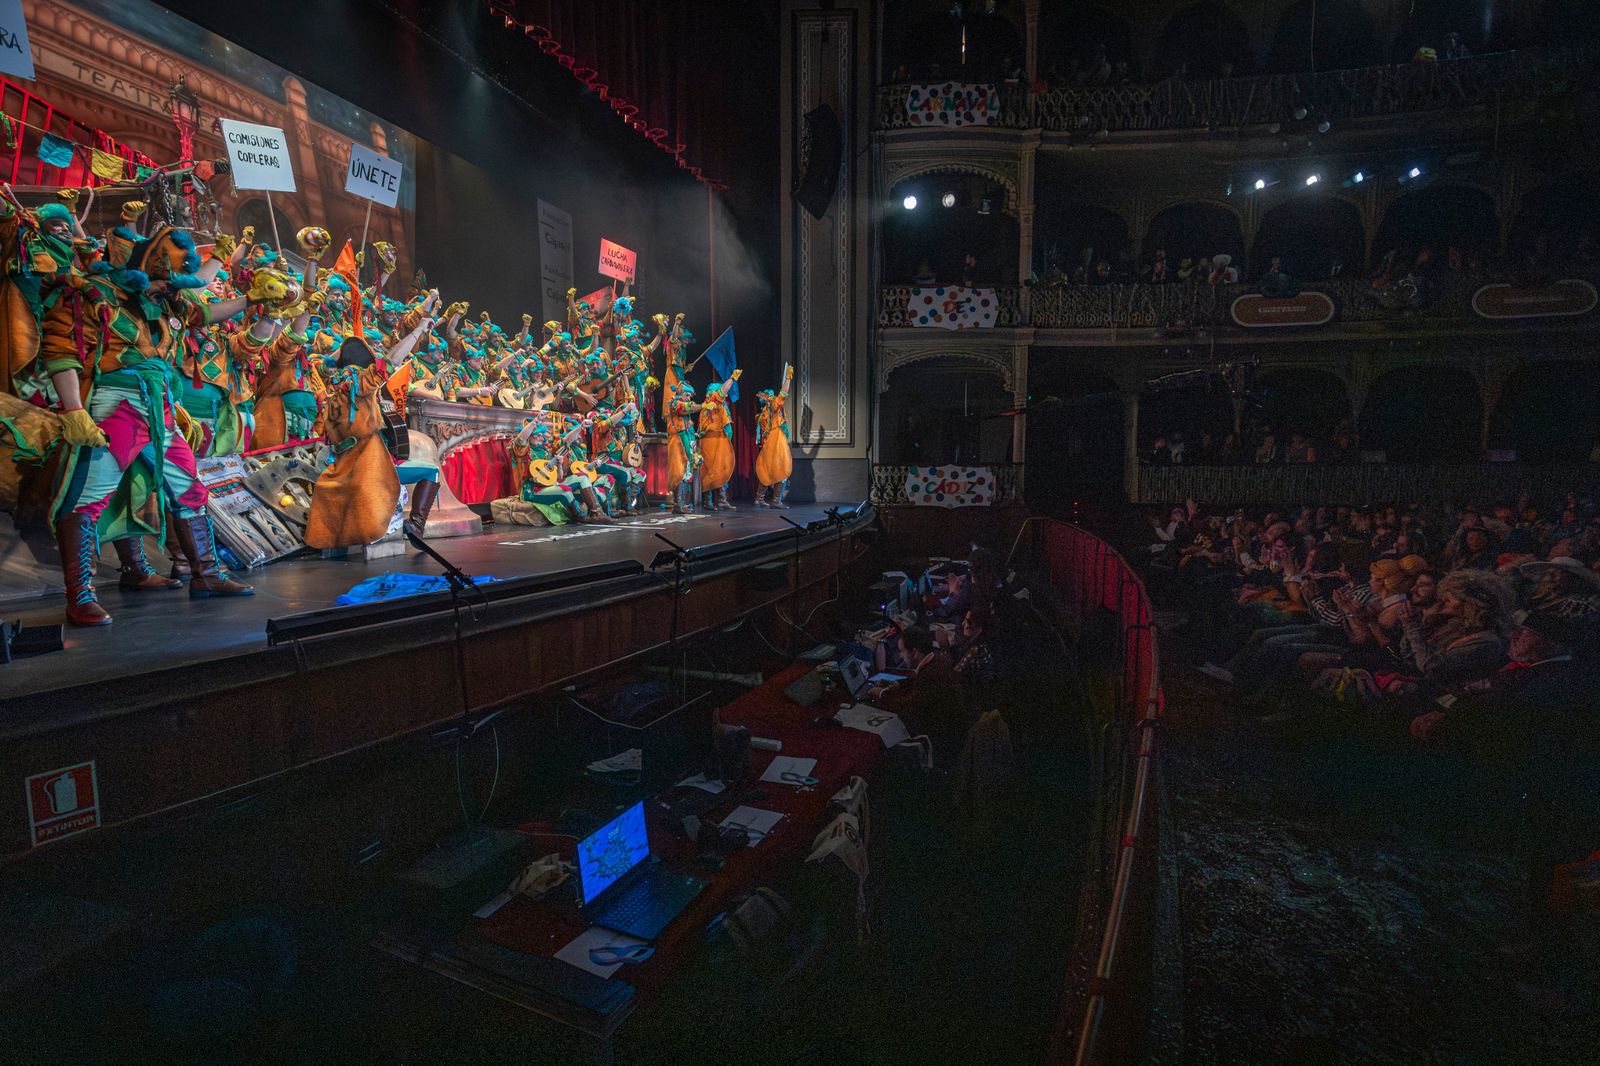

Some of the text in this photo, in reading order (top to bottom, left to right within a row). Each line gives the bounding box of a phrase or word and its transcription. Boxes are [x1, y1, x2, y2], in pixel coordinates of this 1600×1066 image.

[909, 95, 997, 112] CARNAVAL
[228, 131, 280, 150] COMISIONES
[237, 149, 280, 169] COPLERAS
[352, 157, 397, 193] ÚNETE
[607, 248, 628, 263] LUCHA
[943, 300, 967, 314] DE
